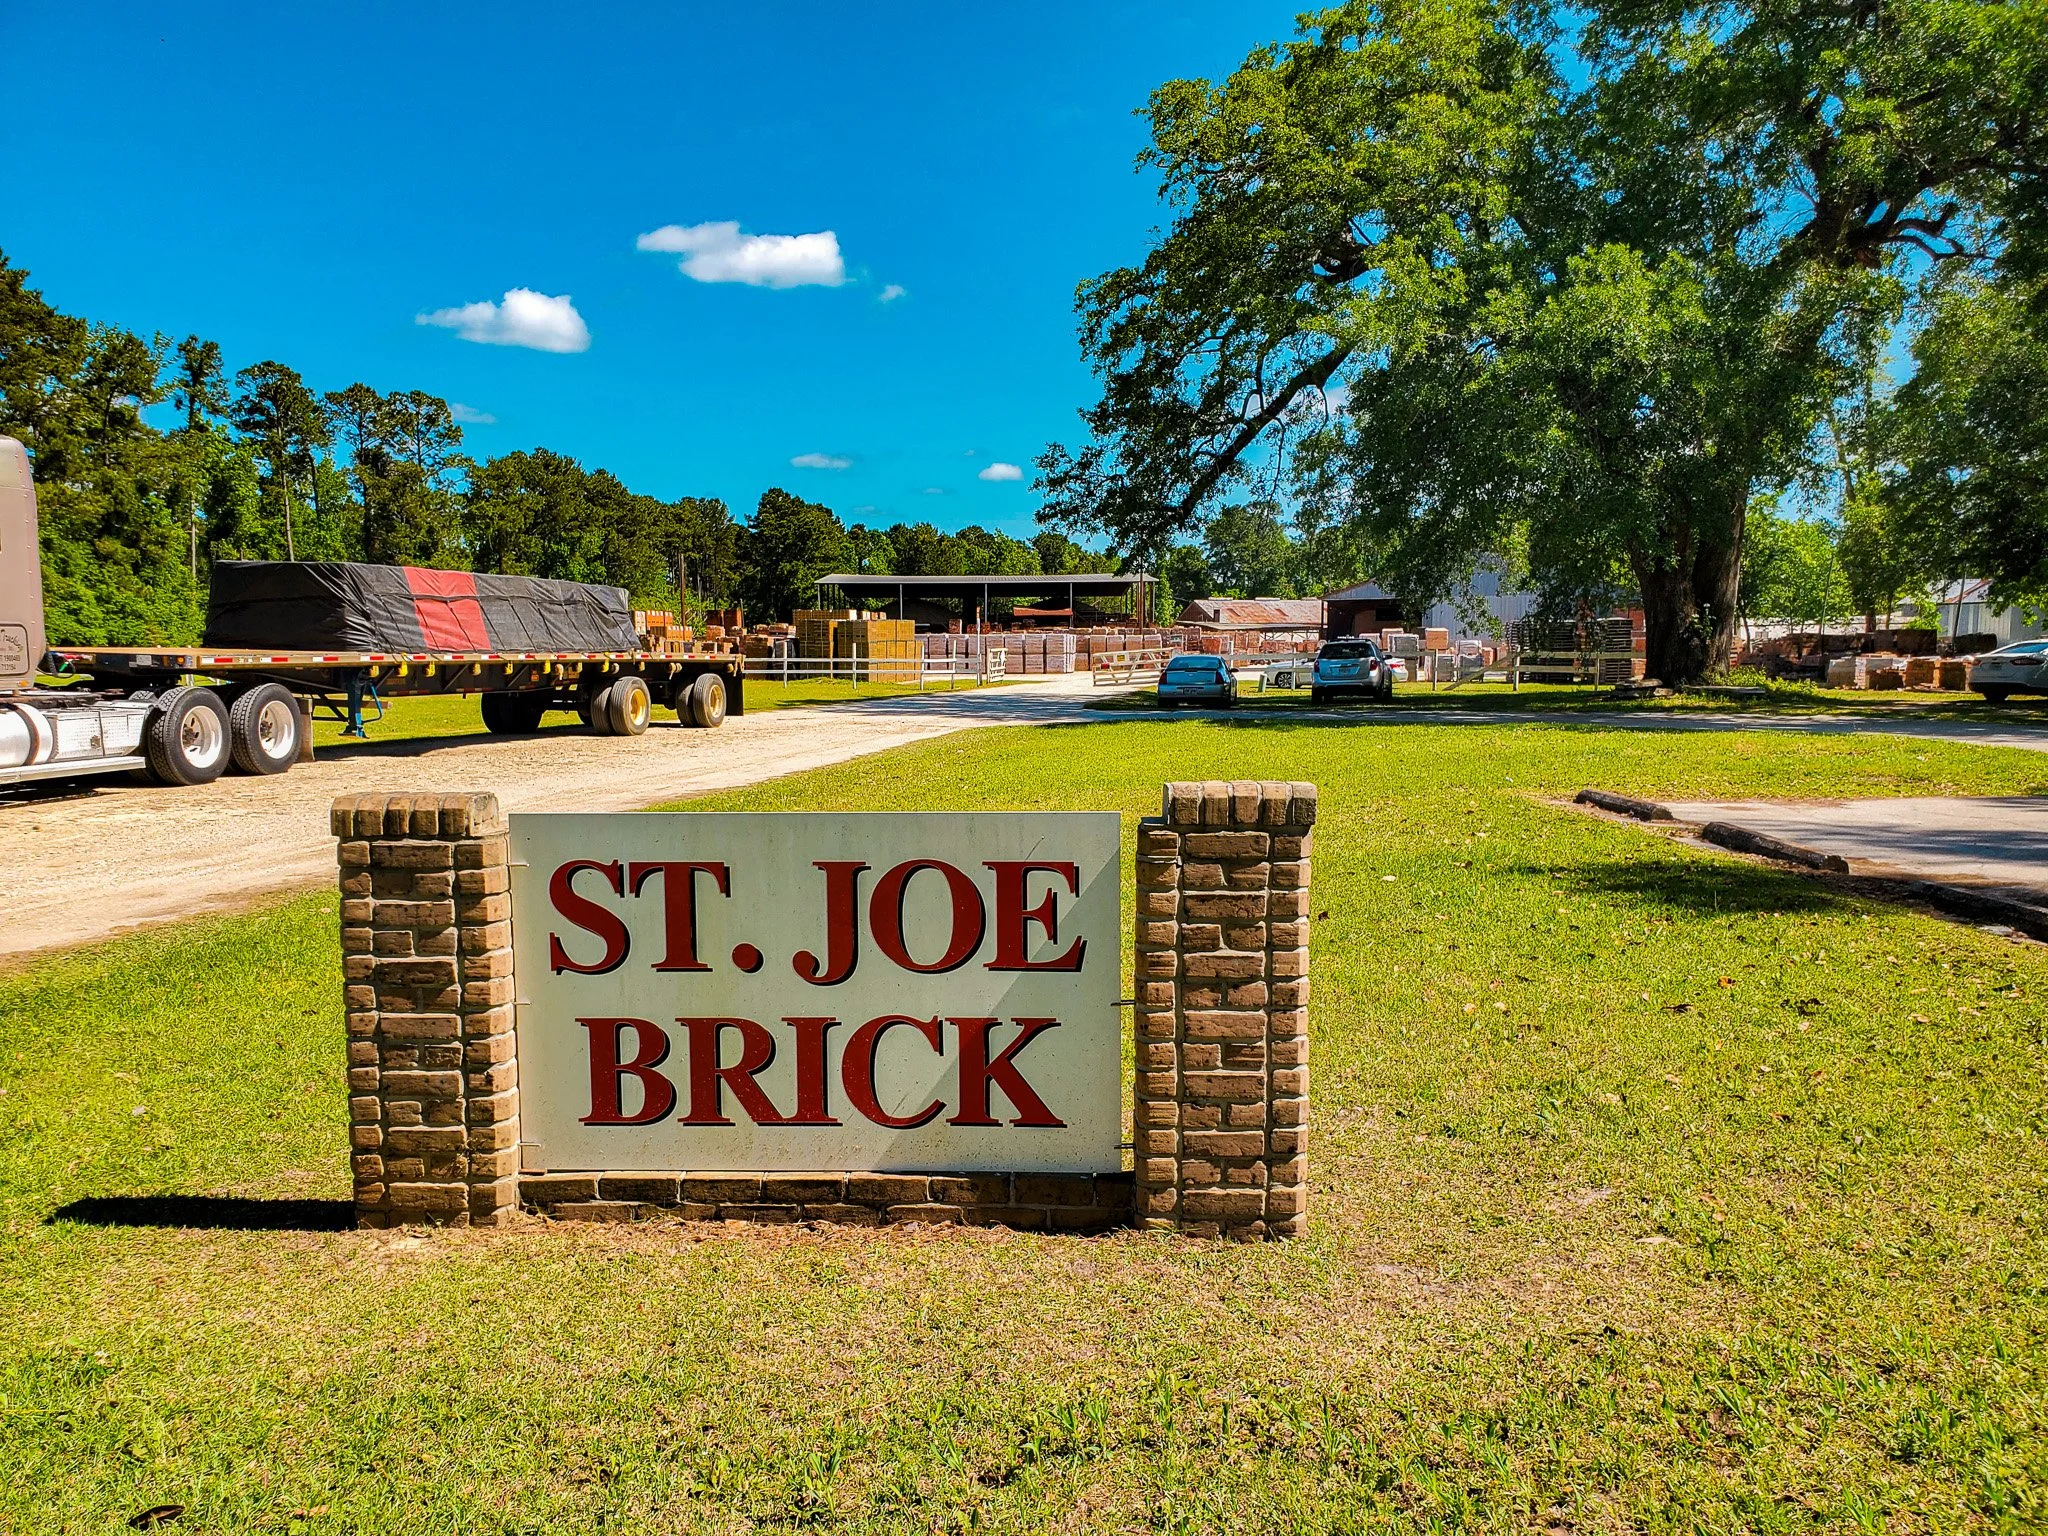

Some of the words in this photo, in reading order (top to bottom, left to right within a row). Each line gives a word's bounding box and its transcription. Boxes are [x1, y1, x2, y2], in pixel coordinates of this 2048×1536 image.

[549, 858, 764, 975] ST.
[792, 858, 1088, 986] JOE
[574, 1014, 1068, 1129] BRICK
